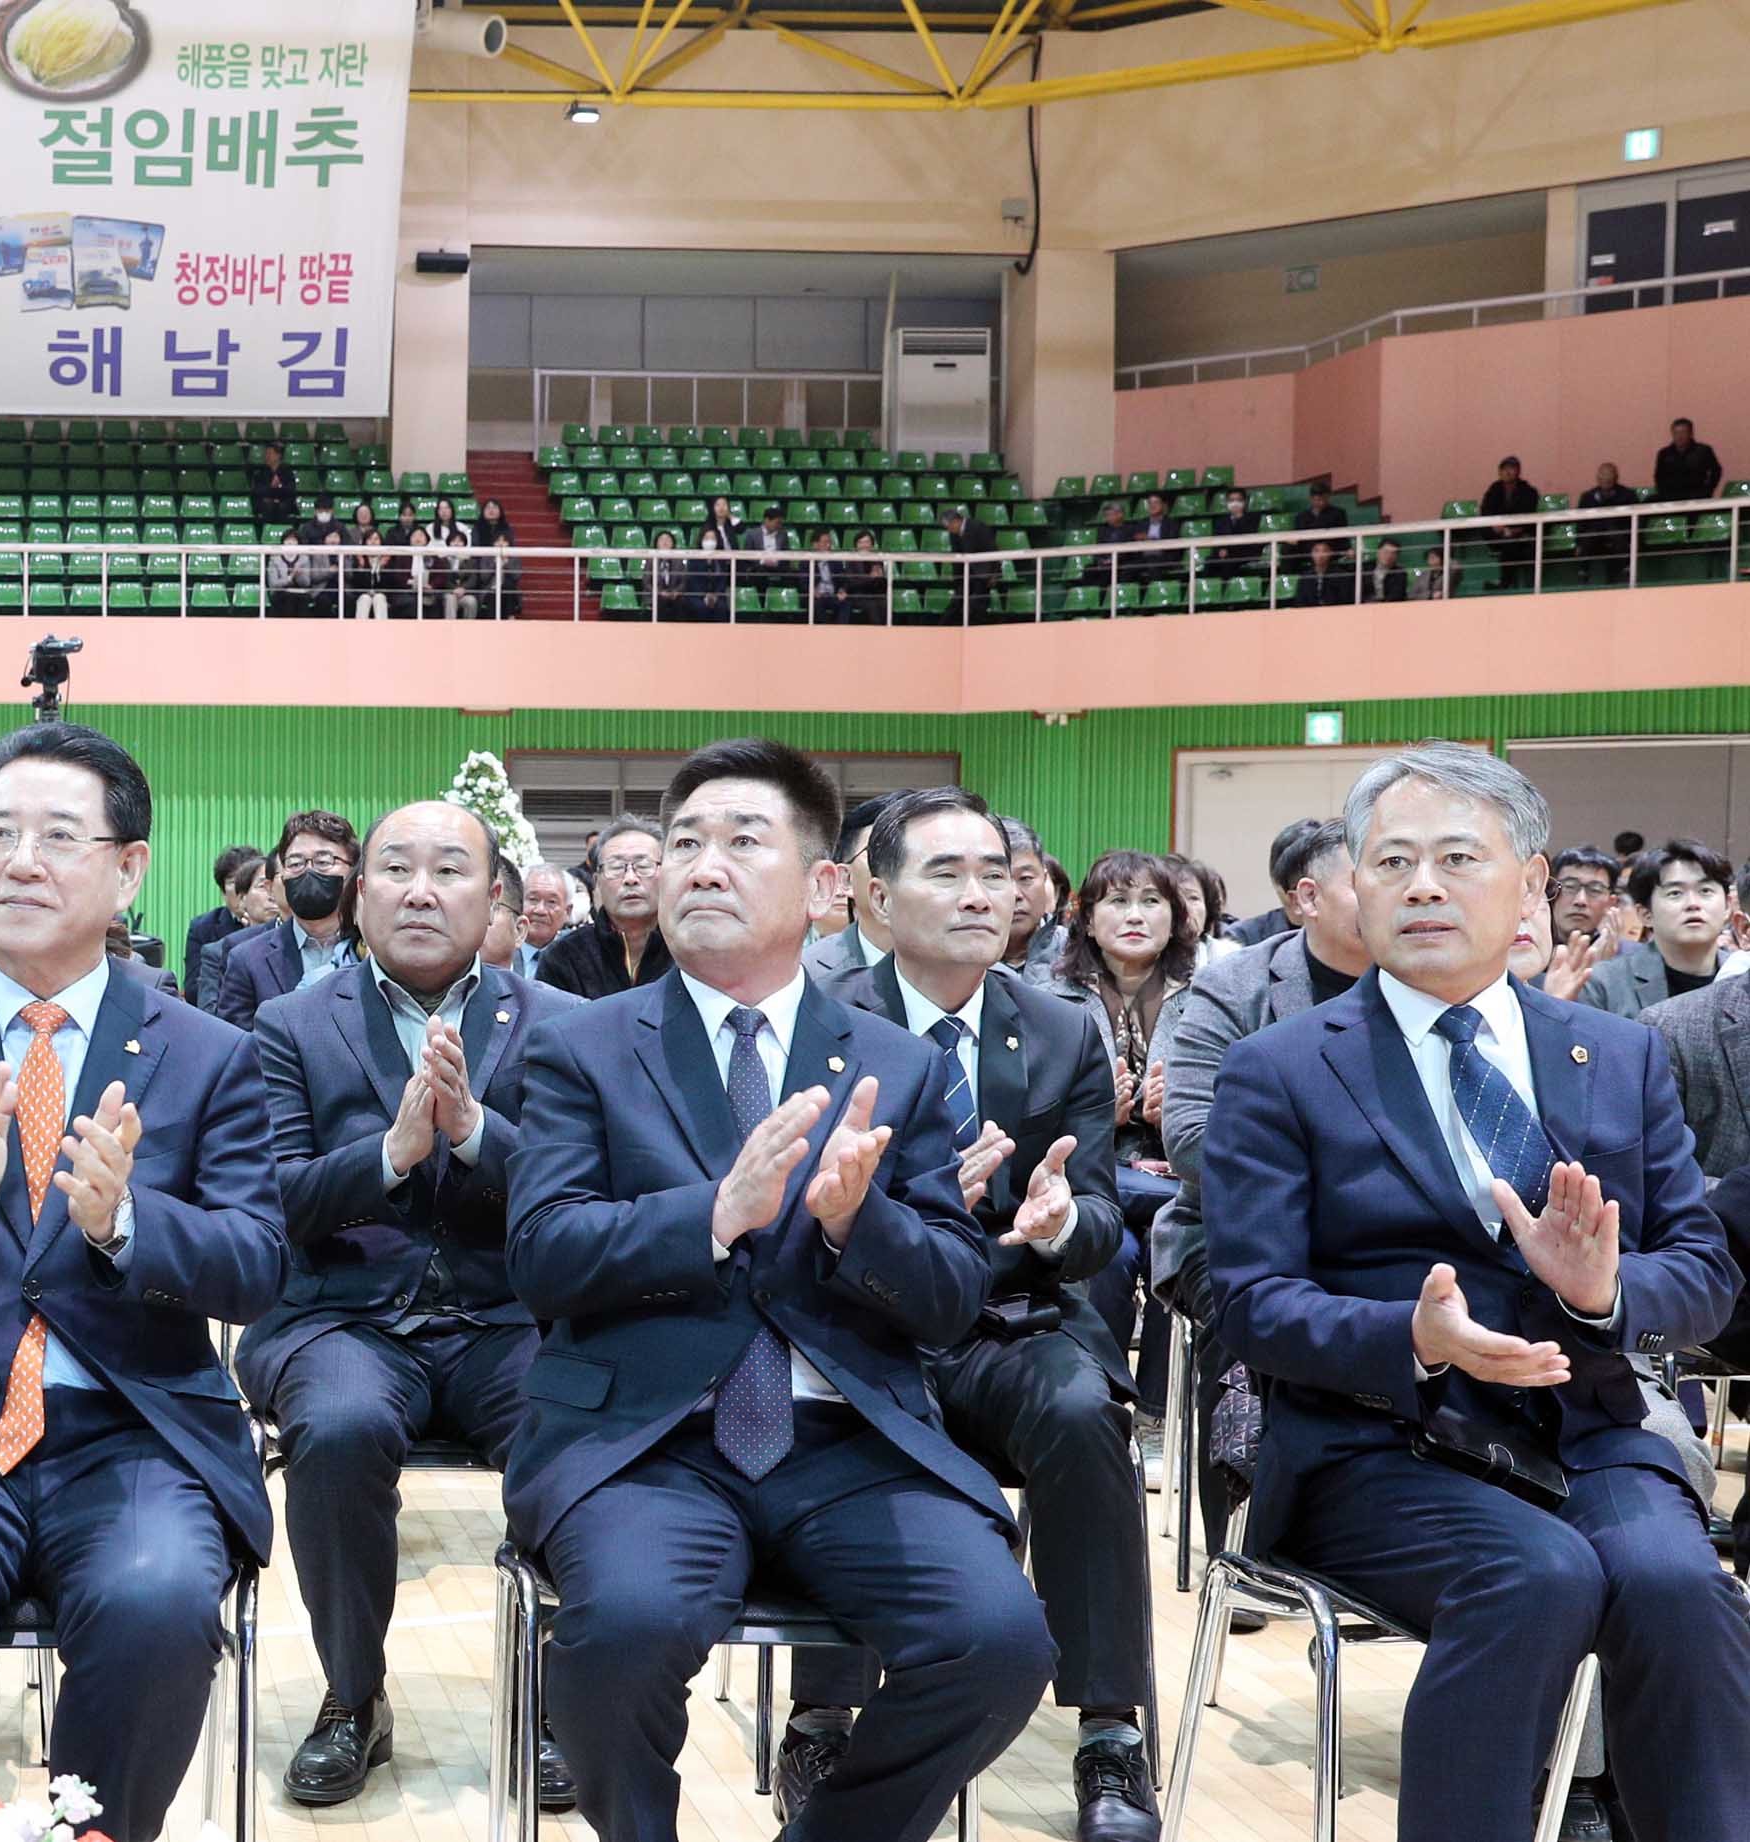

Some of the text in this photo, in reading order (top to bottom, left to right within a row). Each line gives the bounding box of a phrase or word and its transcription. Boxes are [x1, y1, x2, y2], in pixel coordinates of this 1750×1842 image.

[177, 42, 368, 90] 해풍을 맞고 자란
[38, 106, 364, 189] 절임배추
[174, 252, 354, 307] 청정바다 땅끝
